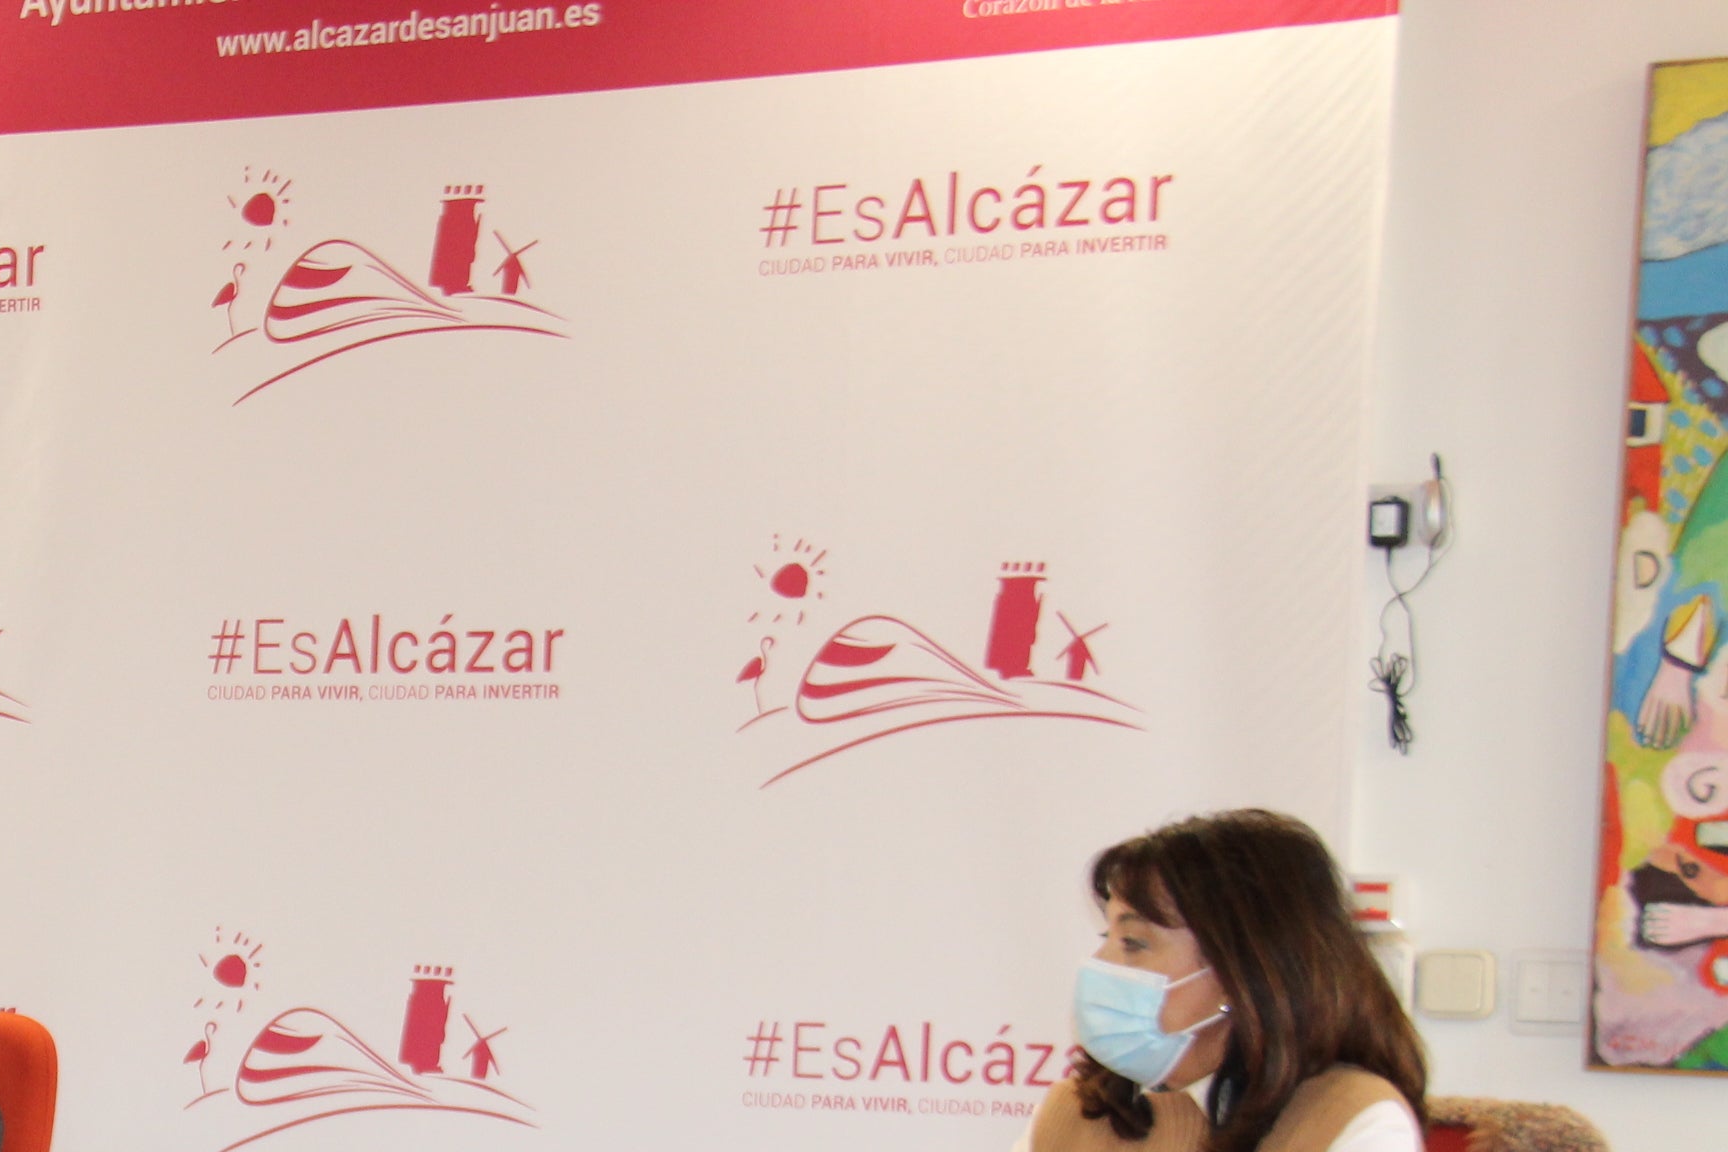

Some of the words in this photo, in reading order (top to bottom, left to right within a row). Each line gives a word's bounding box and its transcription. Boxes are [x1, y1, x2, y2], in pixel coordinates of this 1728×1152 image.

[216, 2, 602, 58] www.alcazardesanjuan.es
[759, 164, 1174, 248] #EsAlcázar
[758, 256, 826, 277] CIUDAD
[832, 254, 879, 272] PARA
[885, 251, 938, 268] VIVIR,
[944, 245, 1014, 265] CIUDAD
[1020, 240, 1070, 259] PARA
[1076, 234, 1168, 255] INVERTIR
[207, 613, 564, 675] #EsAlcázar
[207, 685, 266, 701] CIUDAD
[272, 685, 312, 701] PARA
[317, 685, 364, 702] VIVIR,
[368, 685, 429, 701] CIUDAD
[434, 684, 477, 700] PARA
[483, 684, 560, 700] INVERTIR
[743, 1021, 1084, 1087] #EsAlcáz
[742, 1092, 805, 1109] CIUDAD
[811, 1094, 857, 1111] PARA
[861, 1096, 912, 1114] VIVIR,
[917, 1099, 985, 1116] CIUDAD
